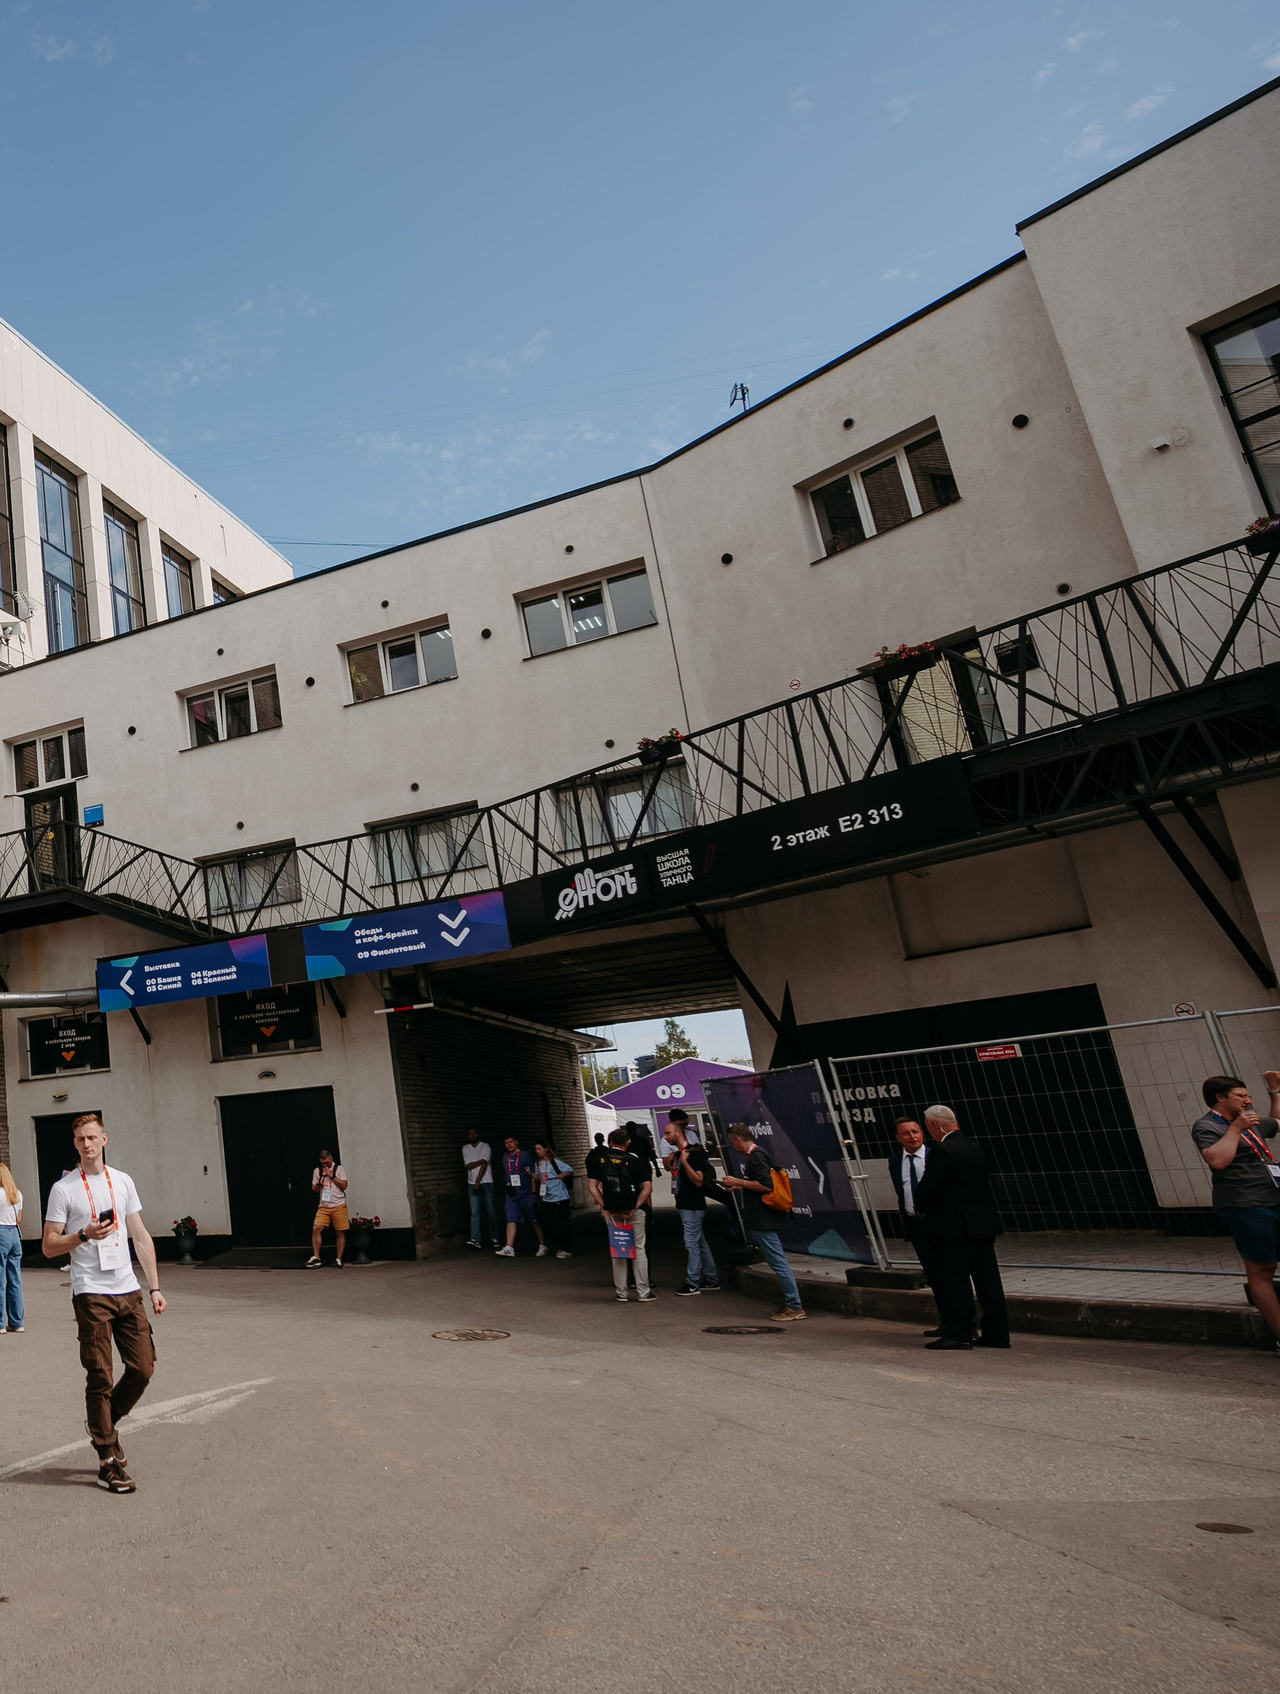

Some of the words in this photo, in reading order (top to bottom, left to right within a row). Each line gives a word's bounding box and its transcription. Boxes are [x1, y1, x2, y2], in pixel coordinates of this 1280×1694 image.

[770, 834, 783, 851] 2
[786, 825, 831, 846] этаж
[867, 803, 903, 825] 313
[656, 848, 690, 863] ВЫСШАЯ
[657, 856, 691, 872] ШКОЛА
[659, 865, 692, 879] УЛИЧНОГО
[660, 872, 695, 888] ТАНЦА
[555, 867, 638, 920] effort
[354, 927, 383, 937] Обеды
[362, 929, 419, 944] кофе-брейки
[357, 951, 370, 959] 09
[370, 941, 427, 957] Фиолетовый
[144, 962, 180, 972] Выставка
[190, 971, 202, 979] 04
[202, 965, 237, 977] Красный
[145, 978, 157, 986] 00
[157, 975, 182, 984] Башня
[203, 972, 237, 984] Зеленый
[146, 985, 157, 993] 03
[157, 981, 183, 991] Синий
[255, 1002, 277, 1011] ВХОД
[59, 1029, 76, 1037] ВХОД
[656, 1084, 686, 1100] 09
[810, 1083, 901, 1105] прковка
